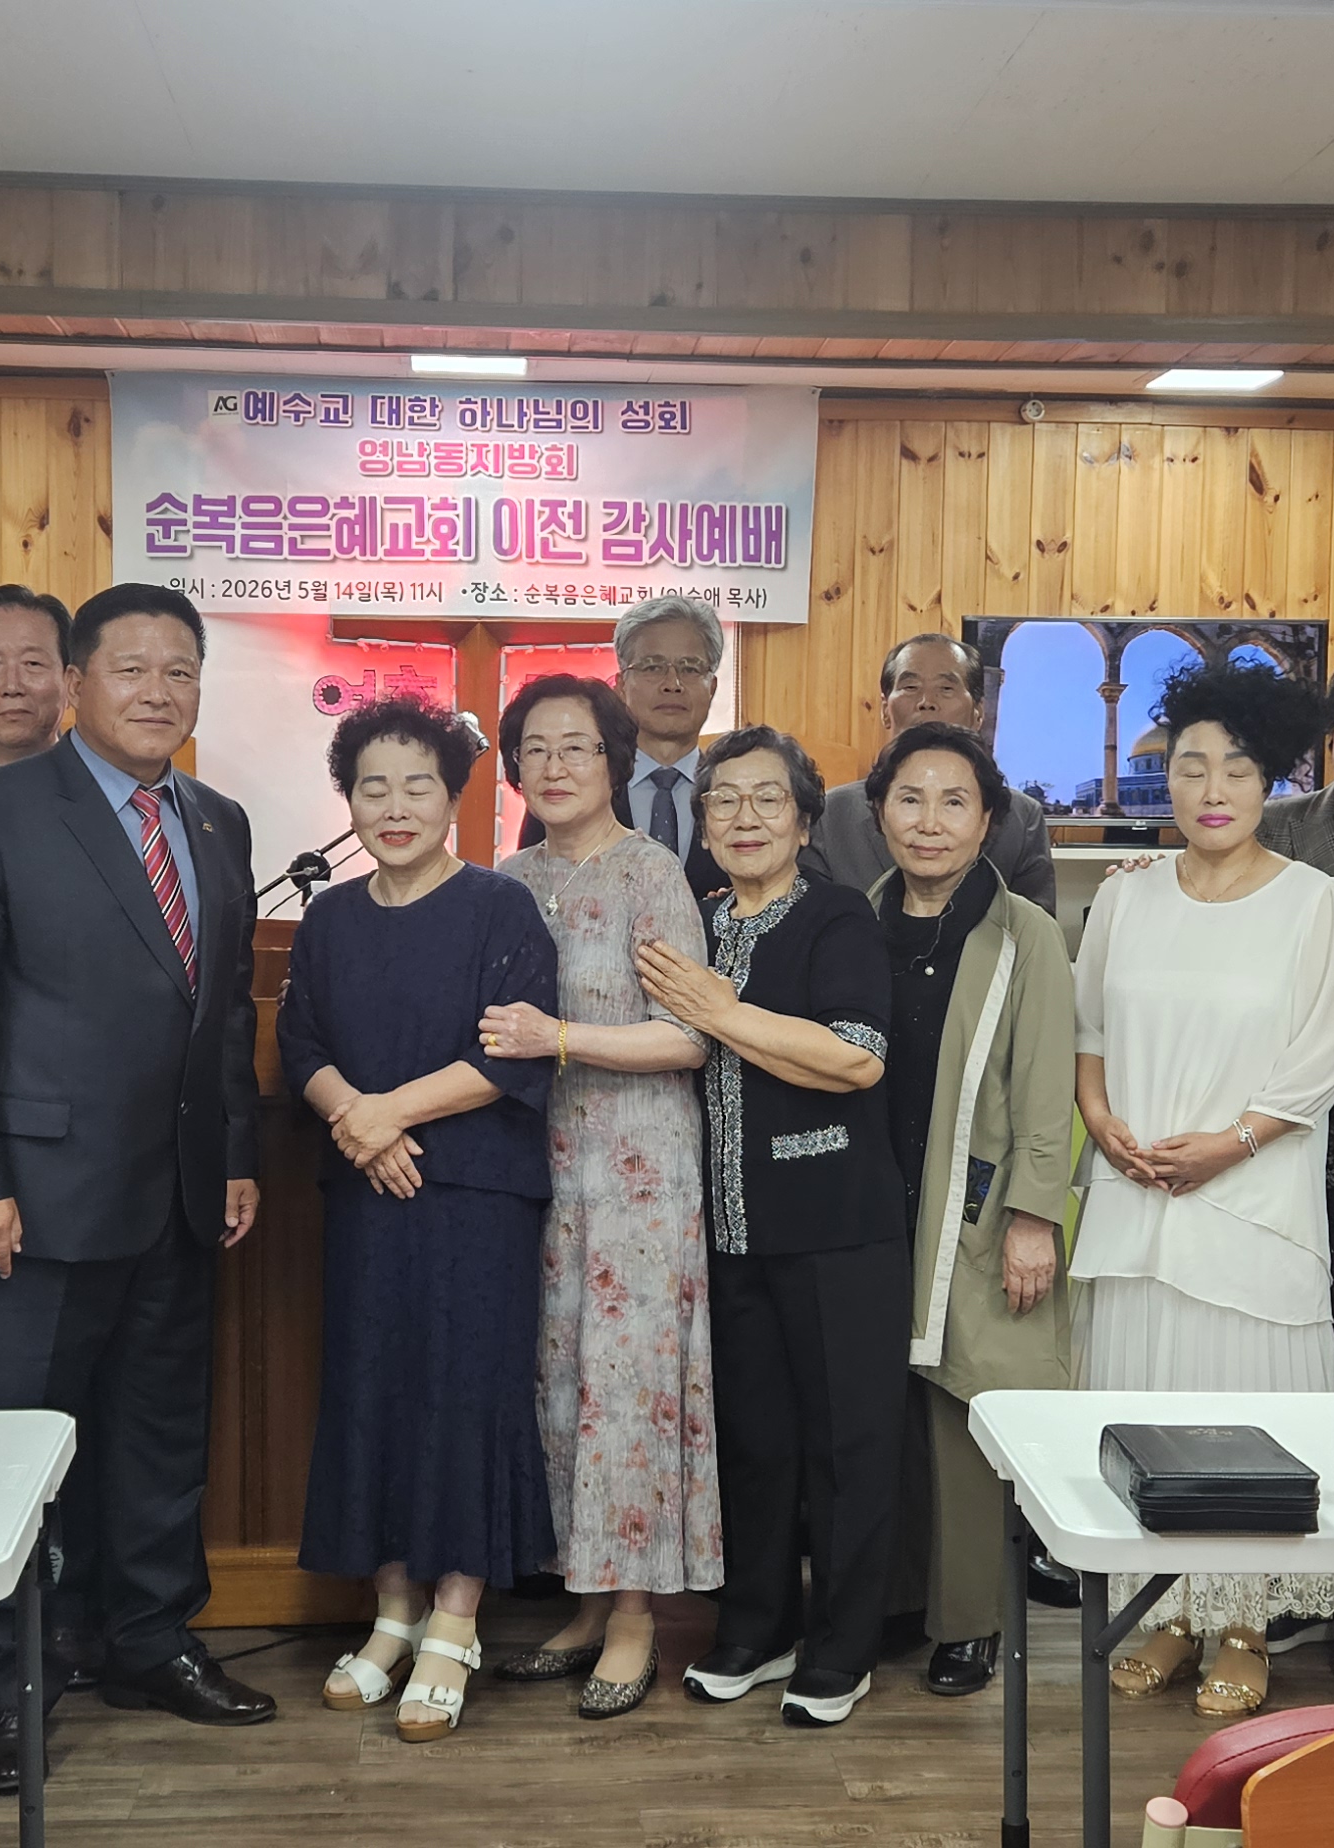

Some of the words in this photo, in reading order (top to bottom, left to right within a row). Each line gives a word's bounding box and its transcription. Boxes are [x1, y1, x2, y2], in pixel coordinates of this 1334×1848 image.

[213, 395, 238, 412] AG
[243, 390, 352, 425] 예수교
[370, 395, 440, 427] 대한
[458, 397, 600, 431] 하나님의
[620, 400, 688, 432] 성회
[358, 440, 575, 477] 영남동지방회
[145, 492, 472, 558] 순복음은혜교회
[493, 498, 584, 560] 이전
[602, 501, 783, 565] 감사예배
[221, 579, 291, 600] 2026년
[297, 580, 328, 601] 5월
[334, 581, 404, 603] 14일(목)
[410, 581, 443, 603] 11시
[470, 582, 508, 604] 장소
[726, 588, 767, 609] 목사)
